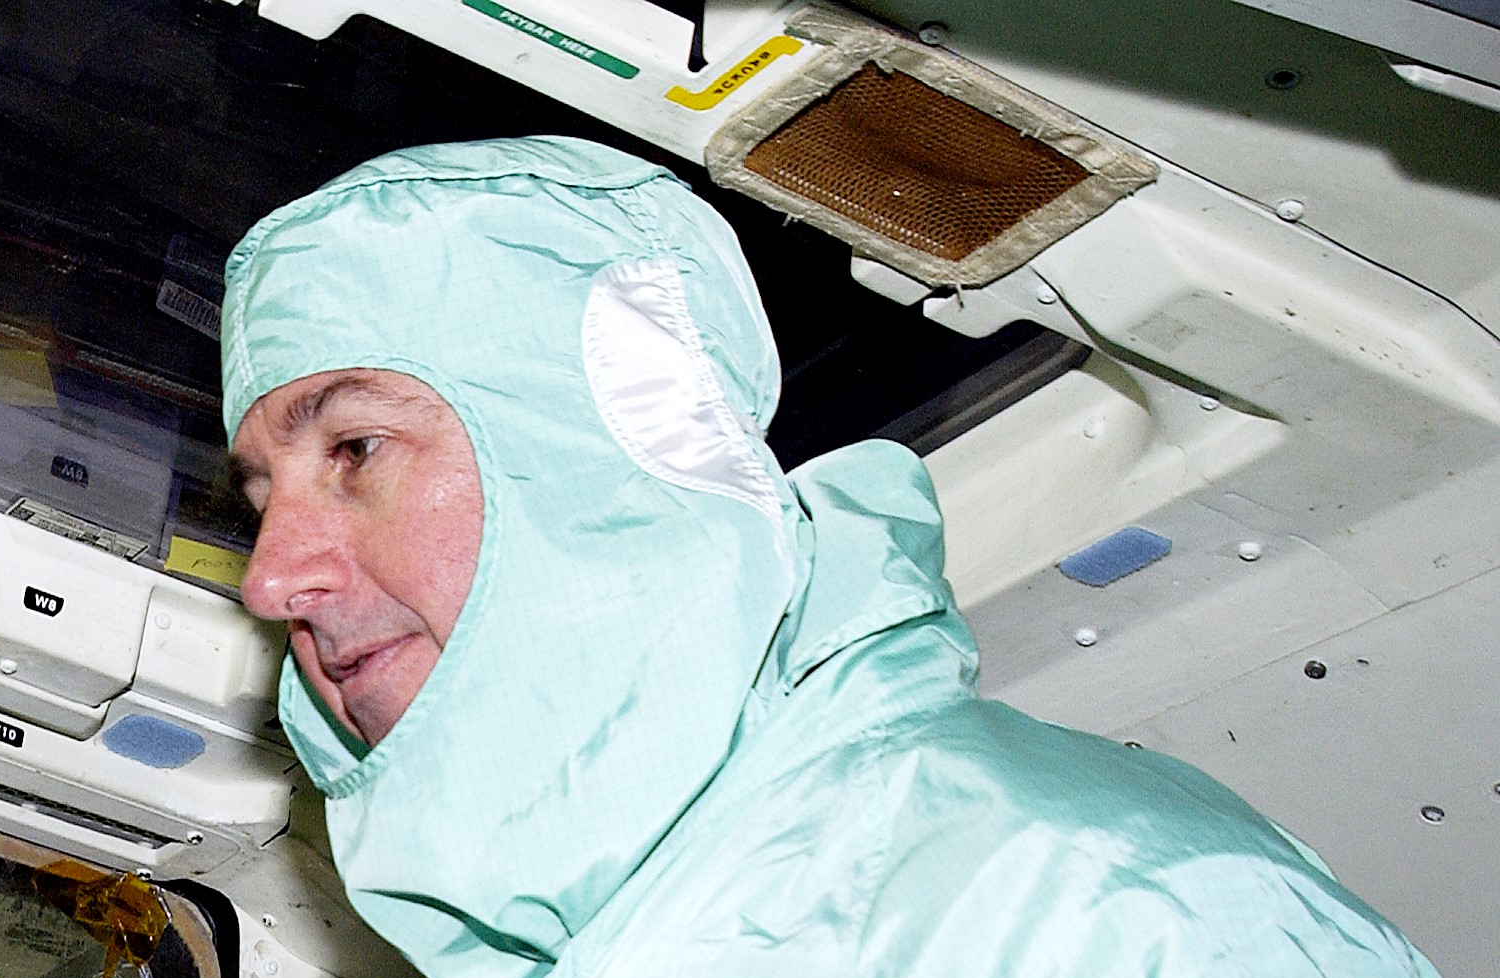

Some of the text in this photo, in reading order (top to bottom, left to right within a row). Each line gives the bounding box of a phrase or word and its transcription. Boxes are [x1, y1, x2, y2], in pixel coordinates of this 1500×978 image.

[500, 10, 597, 59] PRYBAR HERE
[713, 51, 771, 95] BACKUP
[35, 593, 57, 612] W8
